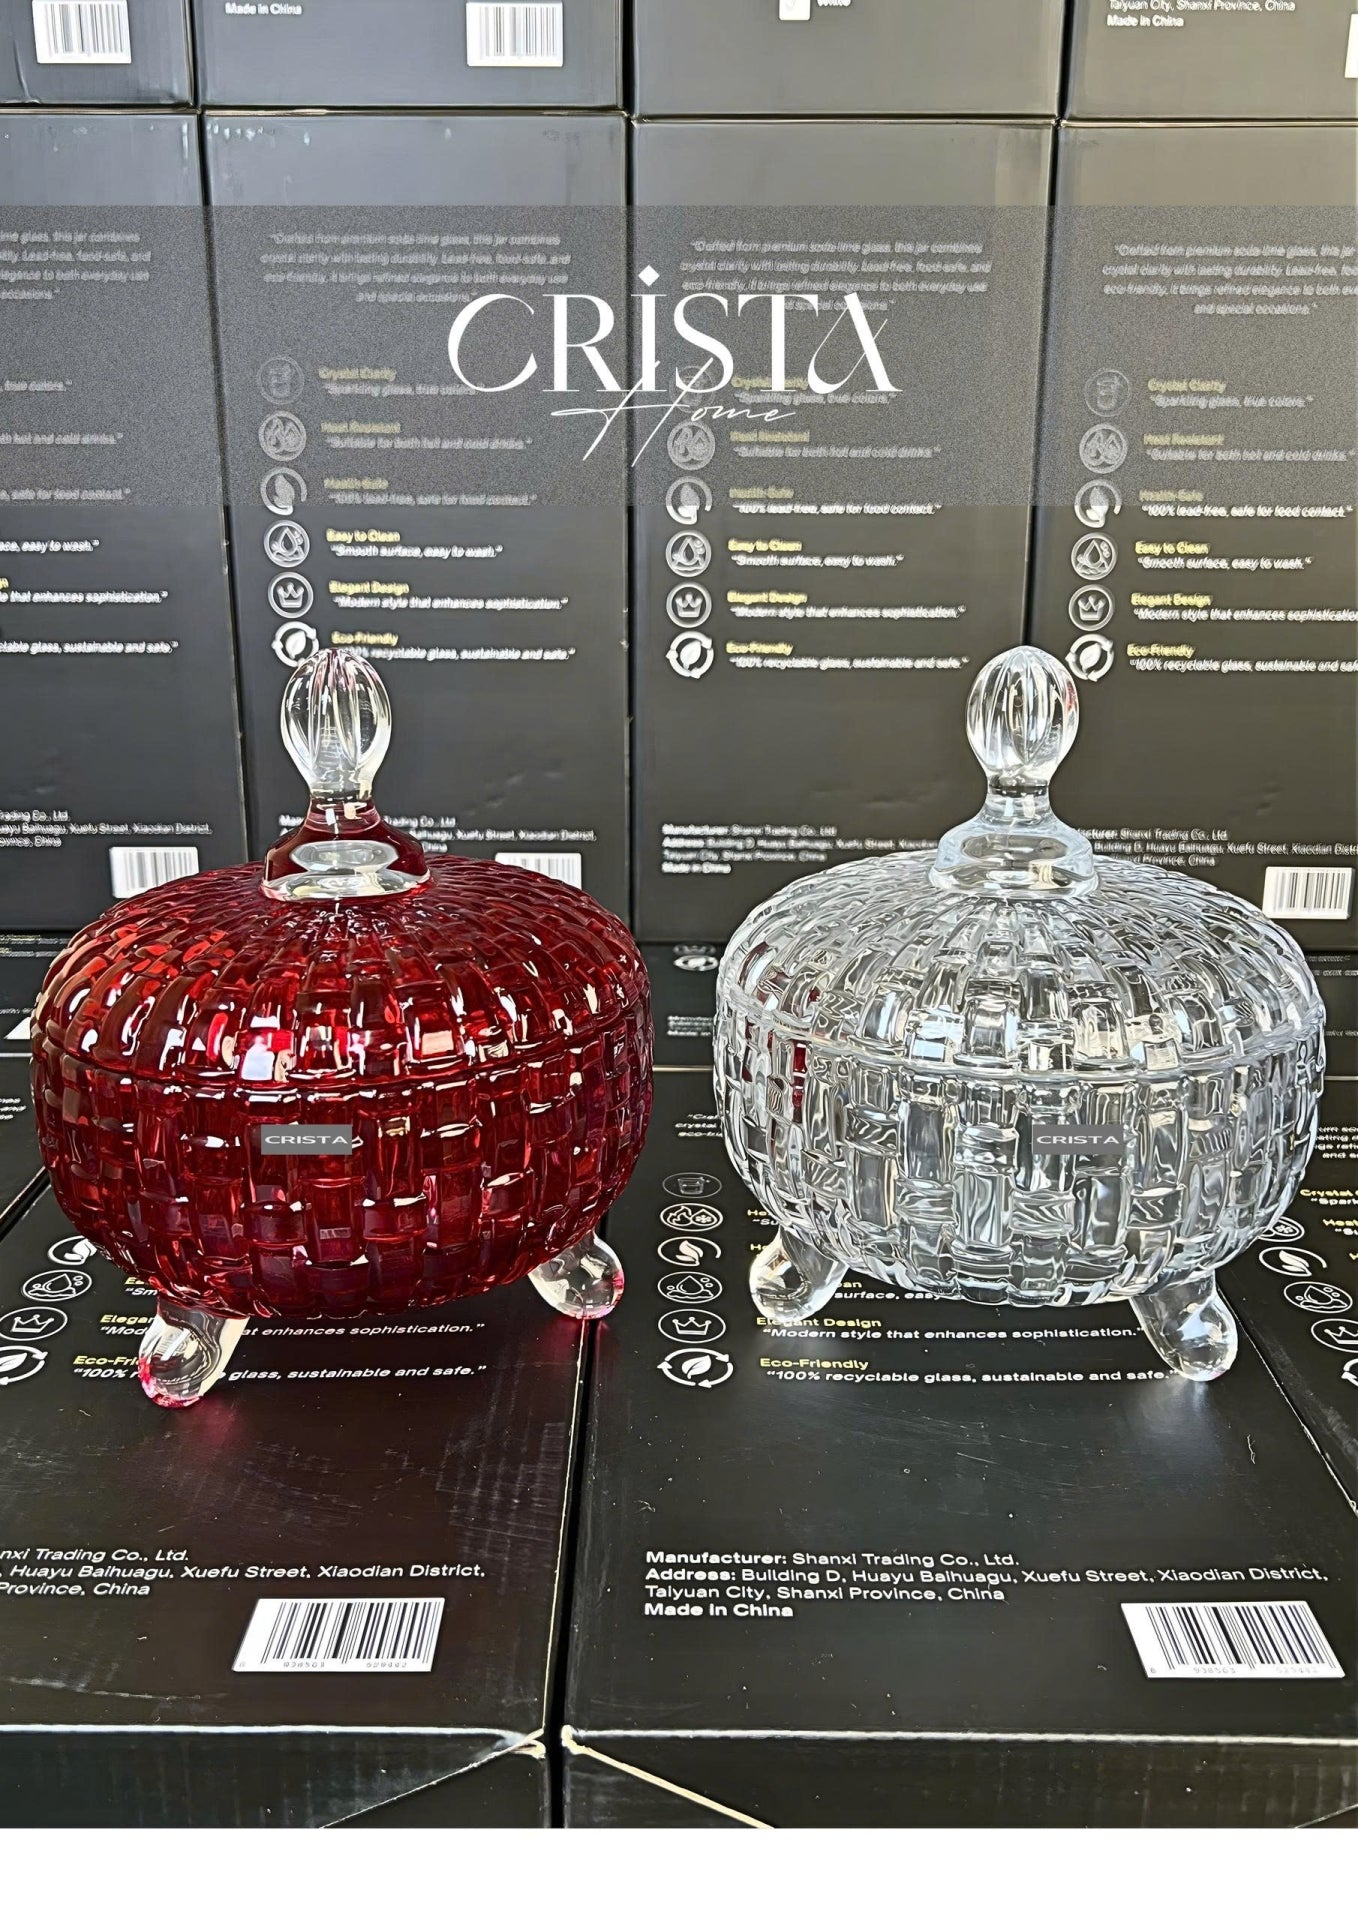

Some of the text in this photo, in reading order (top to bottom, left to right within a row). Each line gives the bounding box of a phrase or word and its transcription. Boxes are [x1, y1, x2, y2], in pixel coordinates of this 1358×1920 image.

[225, 2, 302, 15] Made in China
[1107, 15, 1184, 26] Made in China
[1135, 542, 1209, 555] Easy to Clean
[1131, 593, 1212, 607] Elegant Design
[1127, 644, 1195, 658] Eco-Friendly
[834, 1292, 900, 1300] surface,
[262, 1324, 485, 1336] enhances sophistication.”
[824, 1319, 882, 1328] Design
[763, 1328, 836, 1338] “Modern
[840, 1330, 882, 1340] style
[924, 1330, 1007, 1338] enhances
[760, 1358, 869, 1370] Eco-Friendly
[74, 1368, 128, 1378] “100%
[228, 1365, 487, 1381] glass, sustainable and safe.”
[766, 1371, 820, 1381] “100%
[826, 1372, 919, 1382] recyclable
[924, 1373, 976, 1384] glass,
[982, 1372, 1084, 1382] sustainable
[1089, 1371, 1122, 1380] and
[36, 1548, 106, 1563] Trading
[112, 1549, 148, 1562] Co.,
[156, 1550, 189, 1561] Ltd.
[646, 1551, 1020, 1568] Manufacturer: Shanxi Trading Co., Ltd.
[10, 1564, 486, 1580] Huayu Baihuagu, Xuefu Street, Xiaodian District,
[645, 1566, 1329, 1586] Address: Building D, Huayu Baihuagu, Xuefu Street, Xiaodian District,
[94, 1582, 150, 1595] China
[645, 1586, 1004, 1602] Taiyuan City, Shanxi Province, China
[644, 1603, 794, 1616] Made in China
